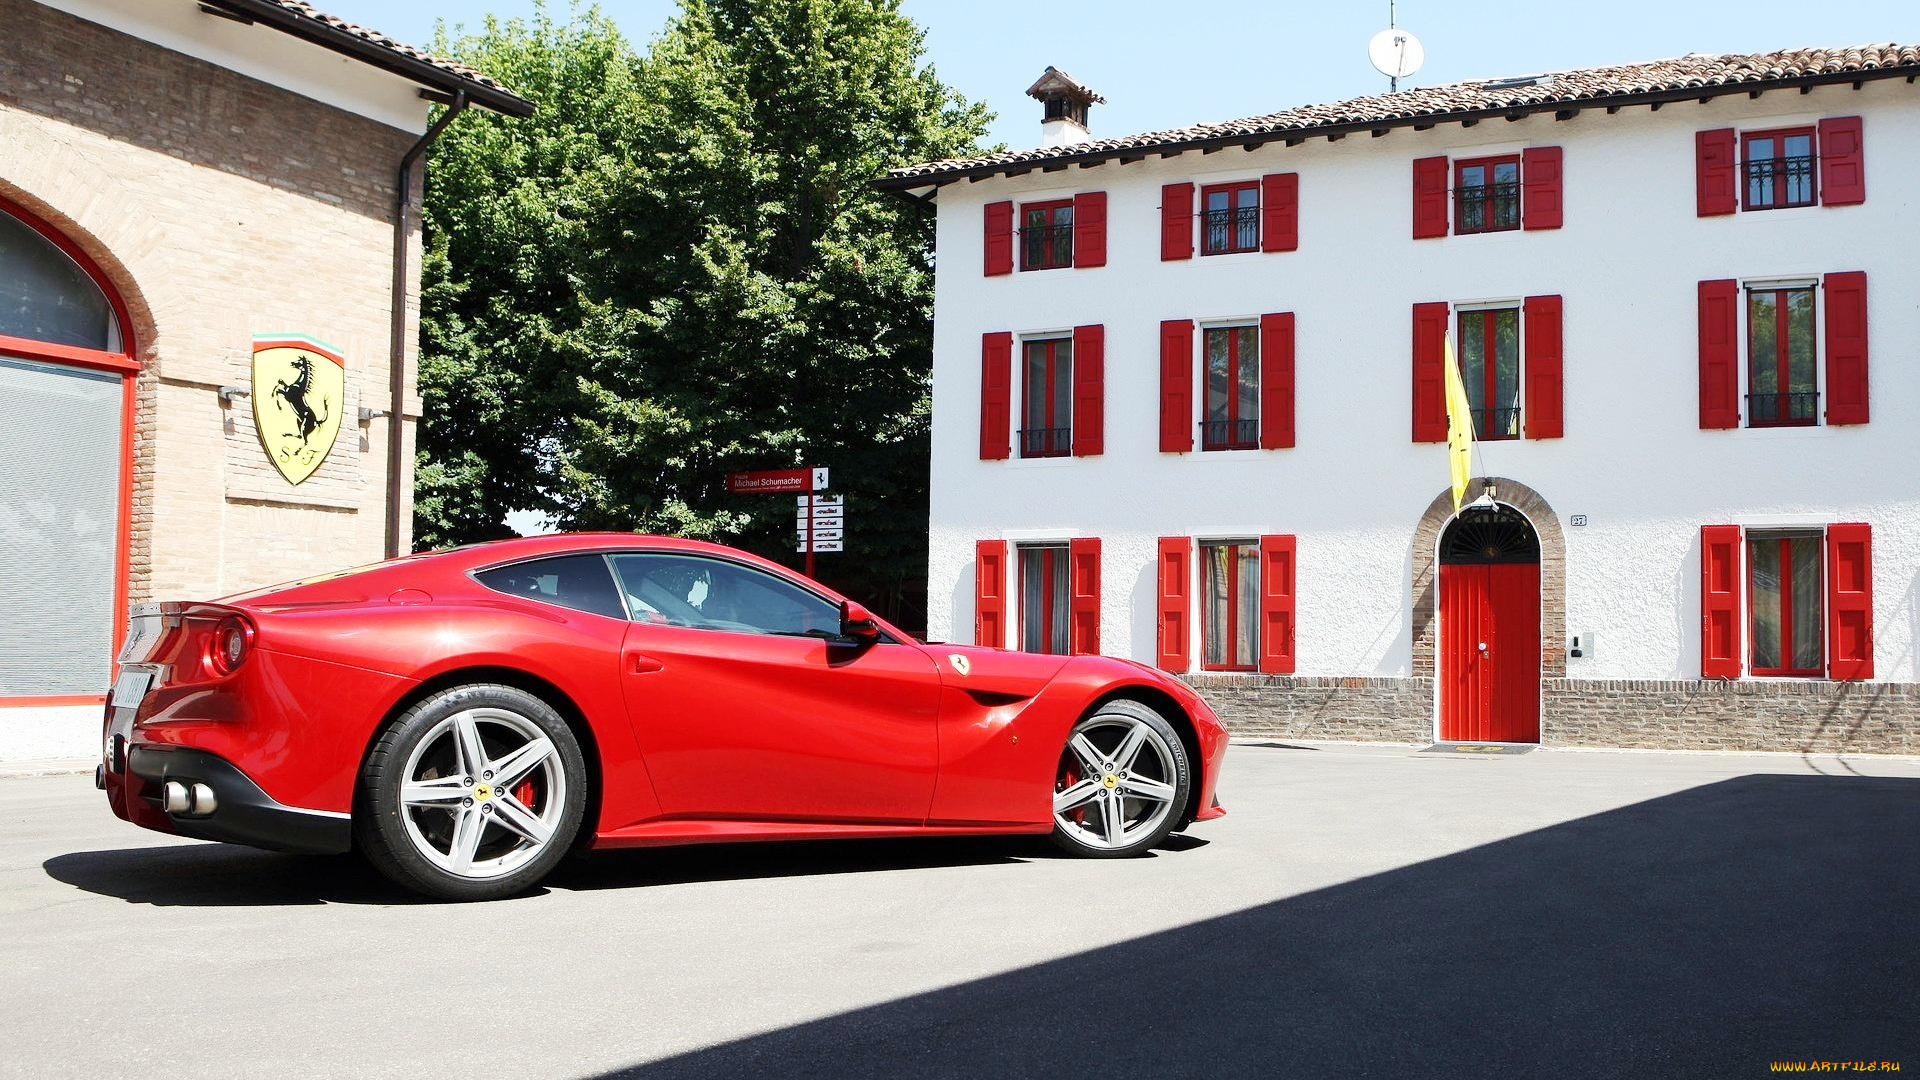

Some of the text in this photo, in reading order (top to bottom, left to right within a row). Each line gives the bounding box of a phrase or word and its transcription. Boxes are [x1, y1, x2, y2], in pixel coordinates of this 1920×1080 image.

[280, 446, 322, 466] S F
[735, 477, 802, 488] Michael Schumacher
[1573, 517, 1583, 525] 27
